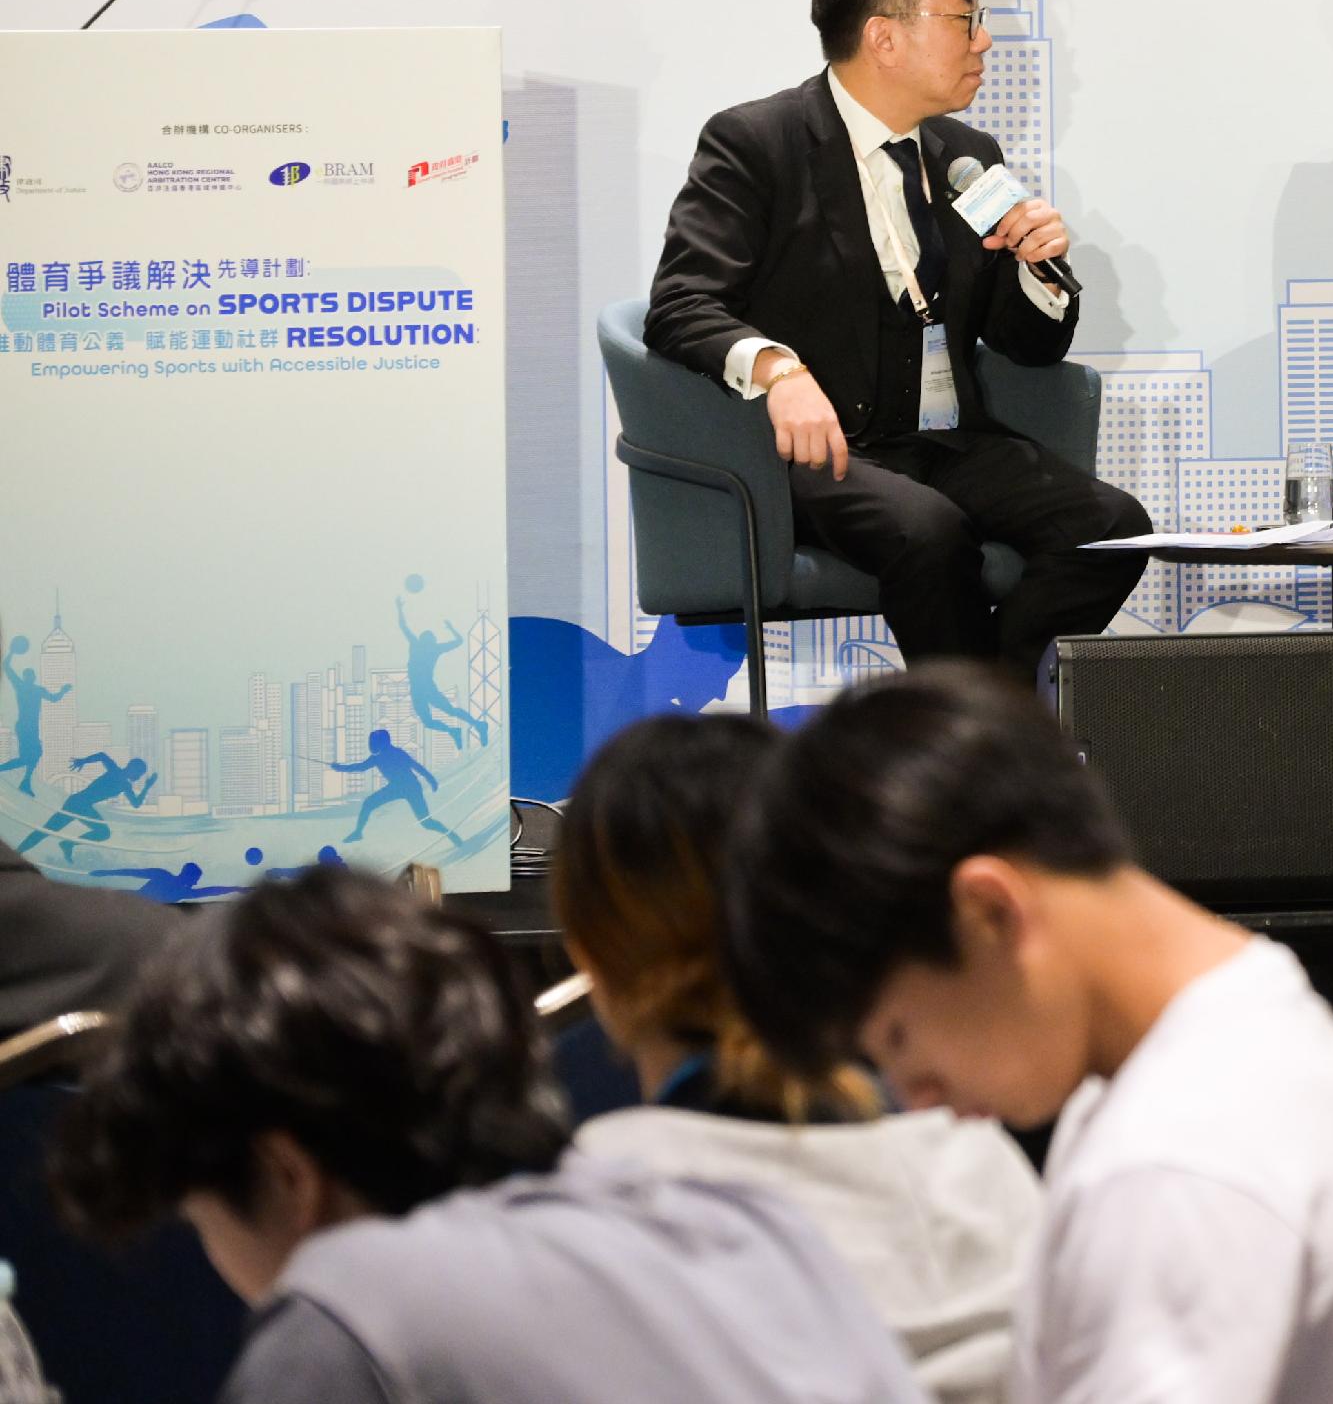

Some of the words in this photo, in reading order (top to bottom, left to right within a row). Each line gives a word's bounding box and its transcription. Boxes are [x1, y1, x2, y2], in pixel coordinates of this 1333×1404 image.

[147, 176, 200, 184] ARBITRATION
[42, 302, 91, 318] Pilot
[98, 301, 179, 317] Scheme
[186, 304, 211, 317] on
[218, 292, 339, 315] SPORTS
[347, 290, 473, 313] DISPUTE
[146, 329, 279, 351] 賦能運動社群
[286, 323, 480, 348] RESOLUTION:
[31, 362, 148, 379] Empowering
[154, 360, 217, 377] Sports
[222, 358, 264, 373] with
[269, 356, 368, 371] Accessible
[373, 355, 441, 370] Justice
